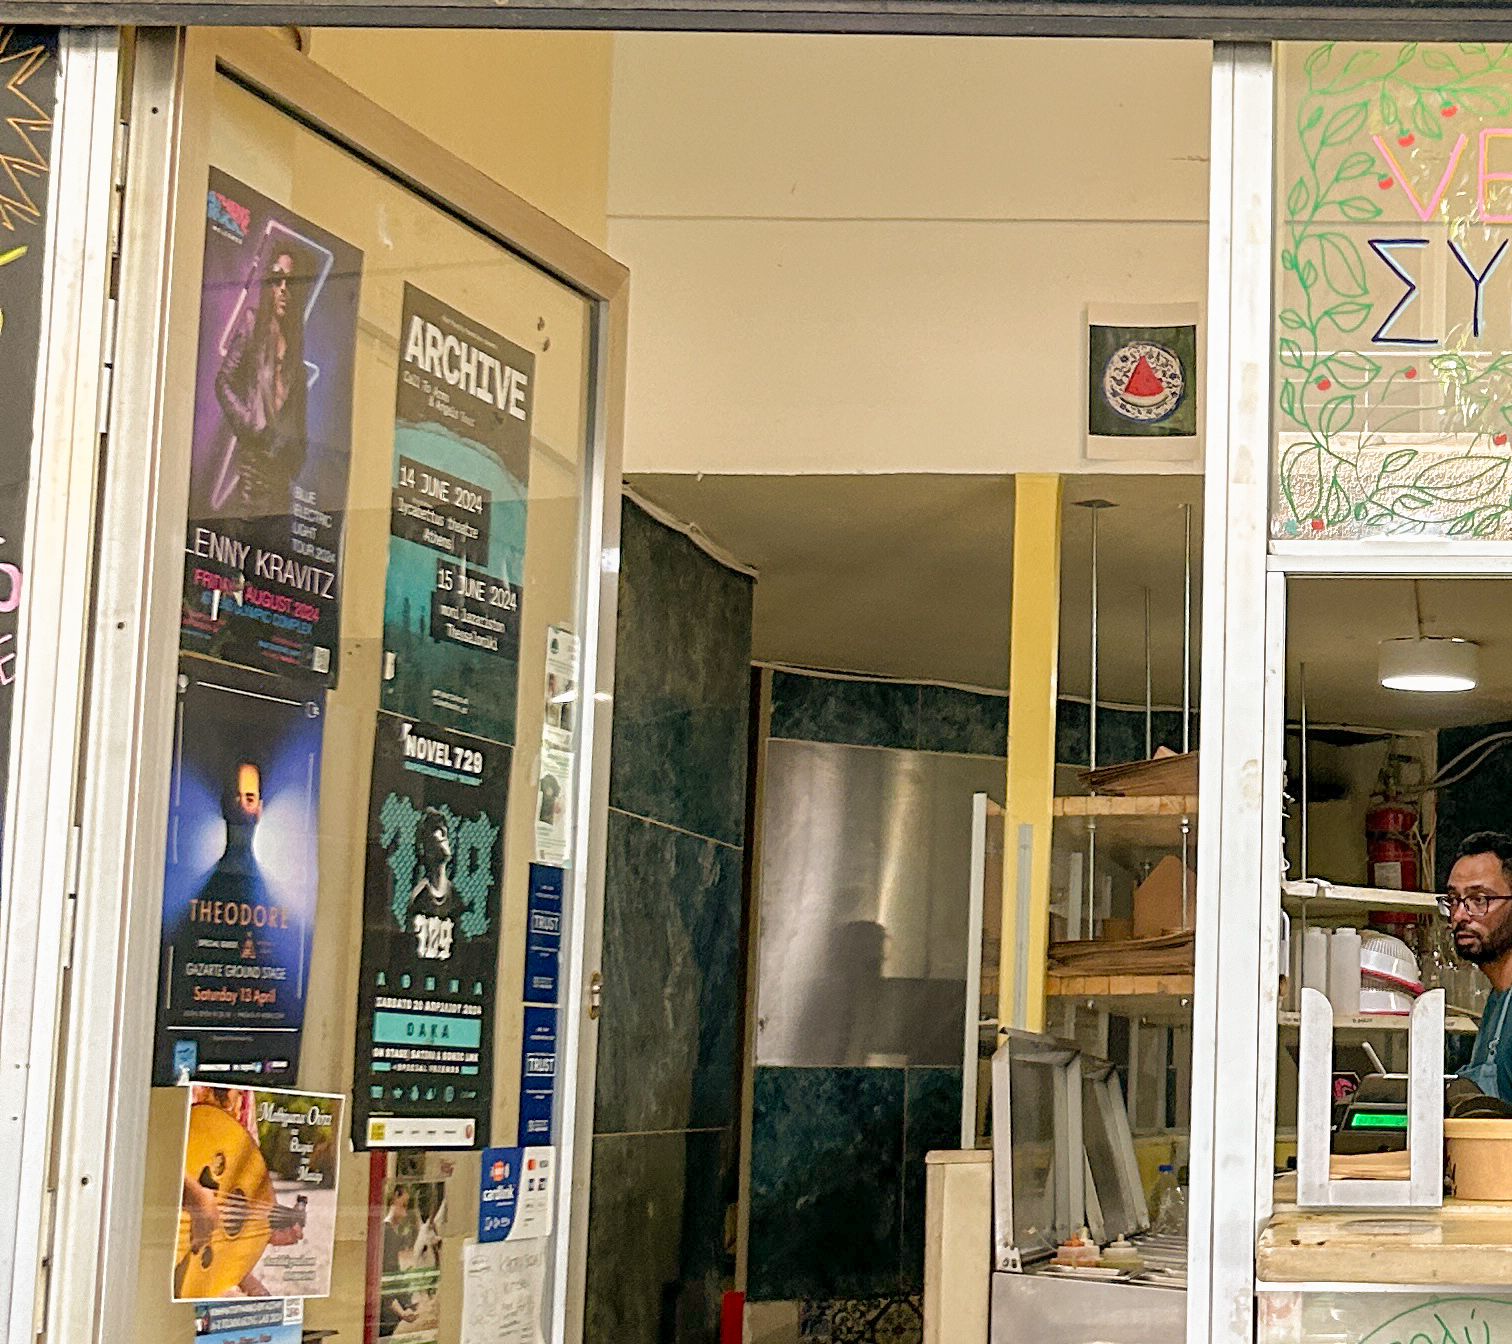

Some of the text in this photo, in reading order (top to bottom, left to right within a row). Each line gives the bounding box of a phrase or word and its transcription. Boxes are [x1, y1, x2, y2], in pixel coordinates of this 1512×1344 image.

[404, 314, 529, 422] ARCHIVE
[400, 465, 484, 515] 14 JUNE 2024
[255, 548, 335, 600] KRAVITZ
[437, 568, 453, 591] 15
[489, 585, 518, 613] 2024
[405, 733, 452, 767] NOVEL
[452, 747, 484, 775] 729
[188, 898, 289, 929] THEODORE
[529, 1057, 555, 1072] TRUST
